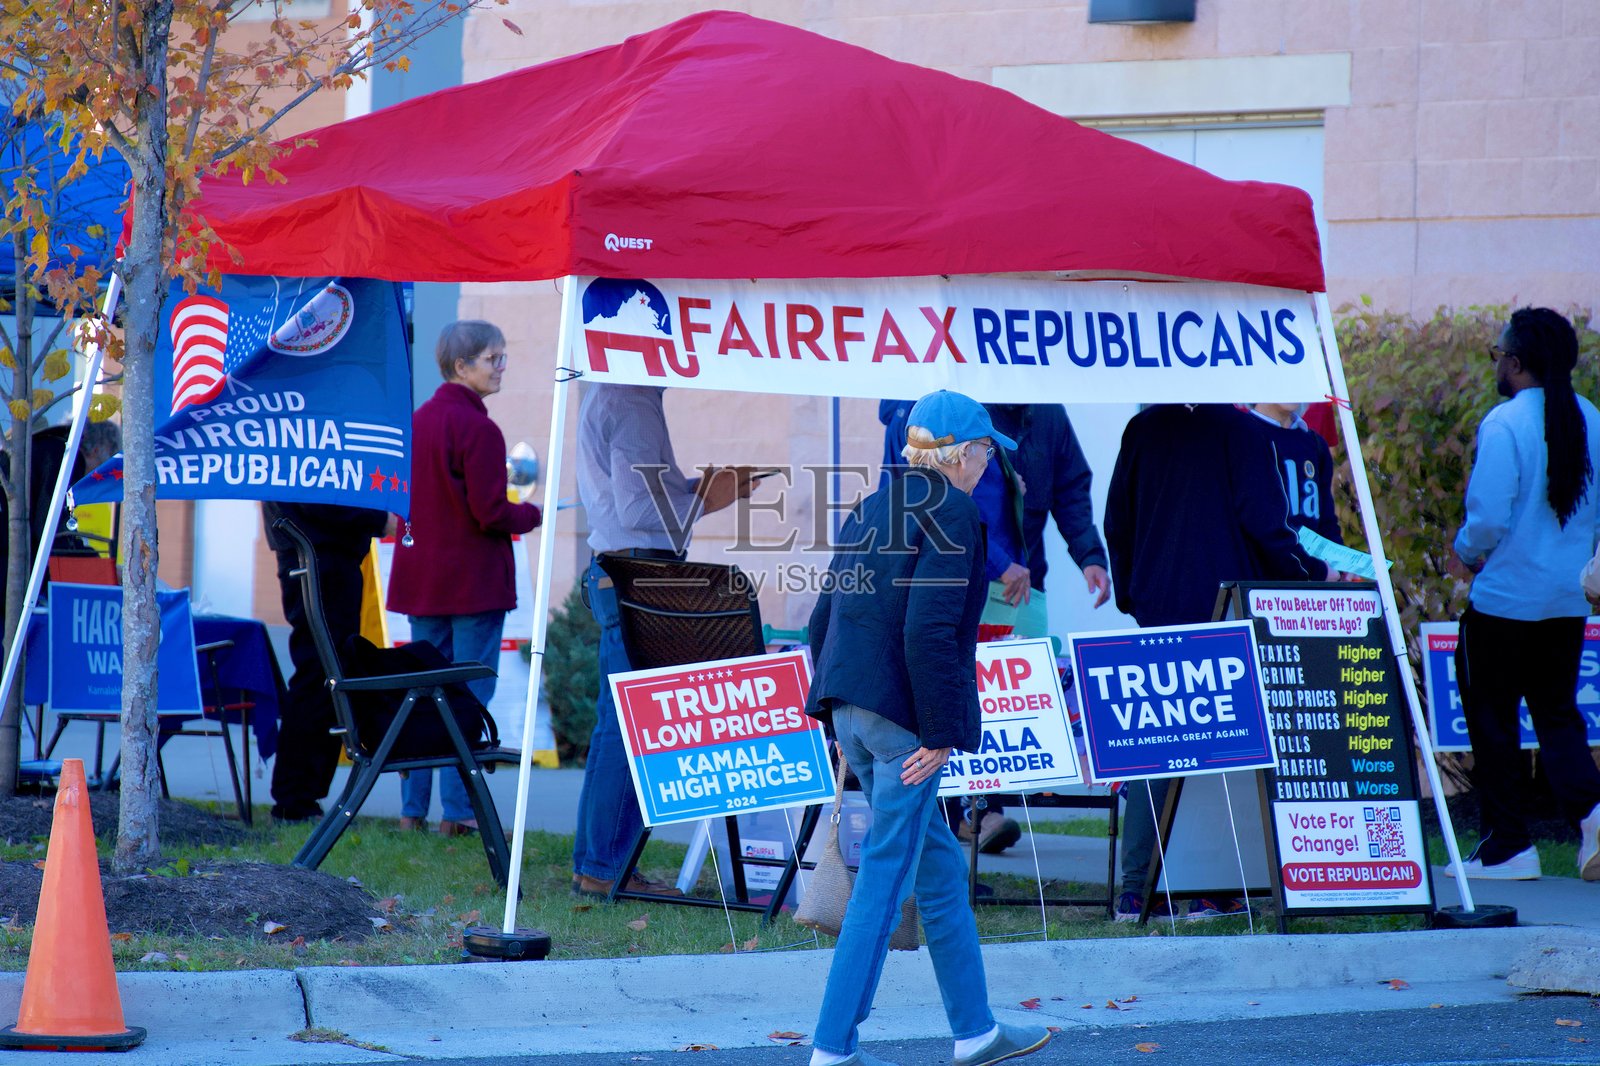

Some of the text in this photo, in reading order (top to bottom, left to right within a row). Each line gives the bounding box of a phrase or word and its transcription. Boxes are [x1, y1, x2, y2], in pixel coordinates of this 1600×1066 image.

[678, 296, 1305, 367] FAIRFAX REPUBLICANS
[189, 391, 305, 422] PROUD
[154, 417, 342, 450] VIRGINIA
[154, 453, 363, 491] REPUBLICAN
[1256, 597, 1376, 614] Are You Better Off Today
[1274, 616, 1362, 634] Than 4 Years Ago?
[87, 651, 123, 675] WA
[1259, 644, 1382, 664] TAXES Higher
[1089, 656, 1246, 701] TRUMP
[1262, 667, 1385, 686] CRIME Higher
[651, 676, 777, 720] TRUMP
[980, 693, 1053, 714] ORDER
[1265, 689, 1388, 709] FOOD PRICES Higher
[1111, 694, 1236, 731] VANCE
[1269, 712, 1390, 731] GAS PRICES Higher
[642, 707, 802, 750] LOW PRICES
[1108, 728, 1249, 748] MAKE AMERICA GREAT AGAIN!
[1273, 735, 1310, 753] OLLS
[1349, 735, 1393, 754] Higher
[677, 743, 785, 777] KAMALA
[969, 752, 1055, 776] BORDER
[1168, 757, 1199, 770] 2024
[1352, 758, 1395, 772] Worse
[659, 761, 812, 803] HIGH PRICES
[968, 778, 1001, 790] 2024
[1277, 780, 1399, 799] EDUCATION Worse
[726, 796, 757, 809] 2024
[1289, 812, 1354, 829] Vote For
[1292, 834, 1359, 856] Change!
[1288, 865, 1414, 882] VOTE REPUBLICAN!
